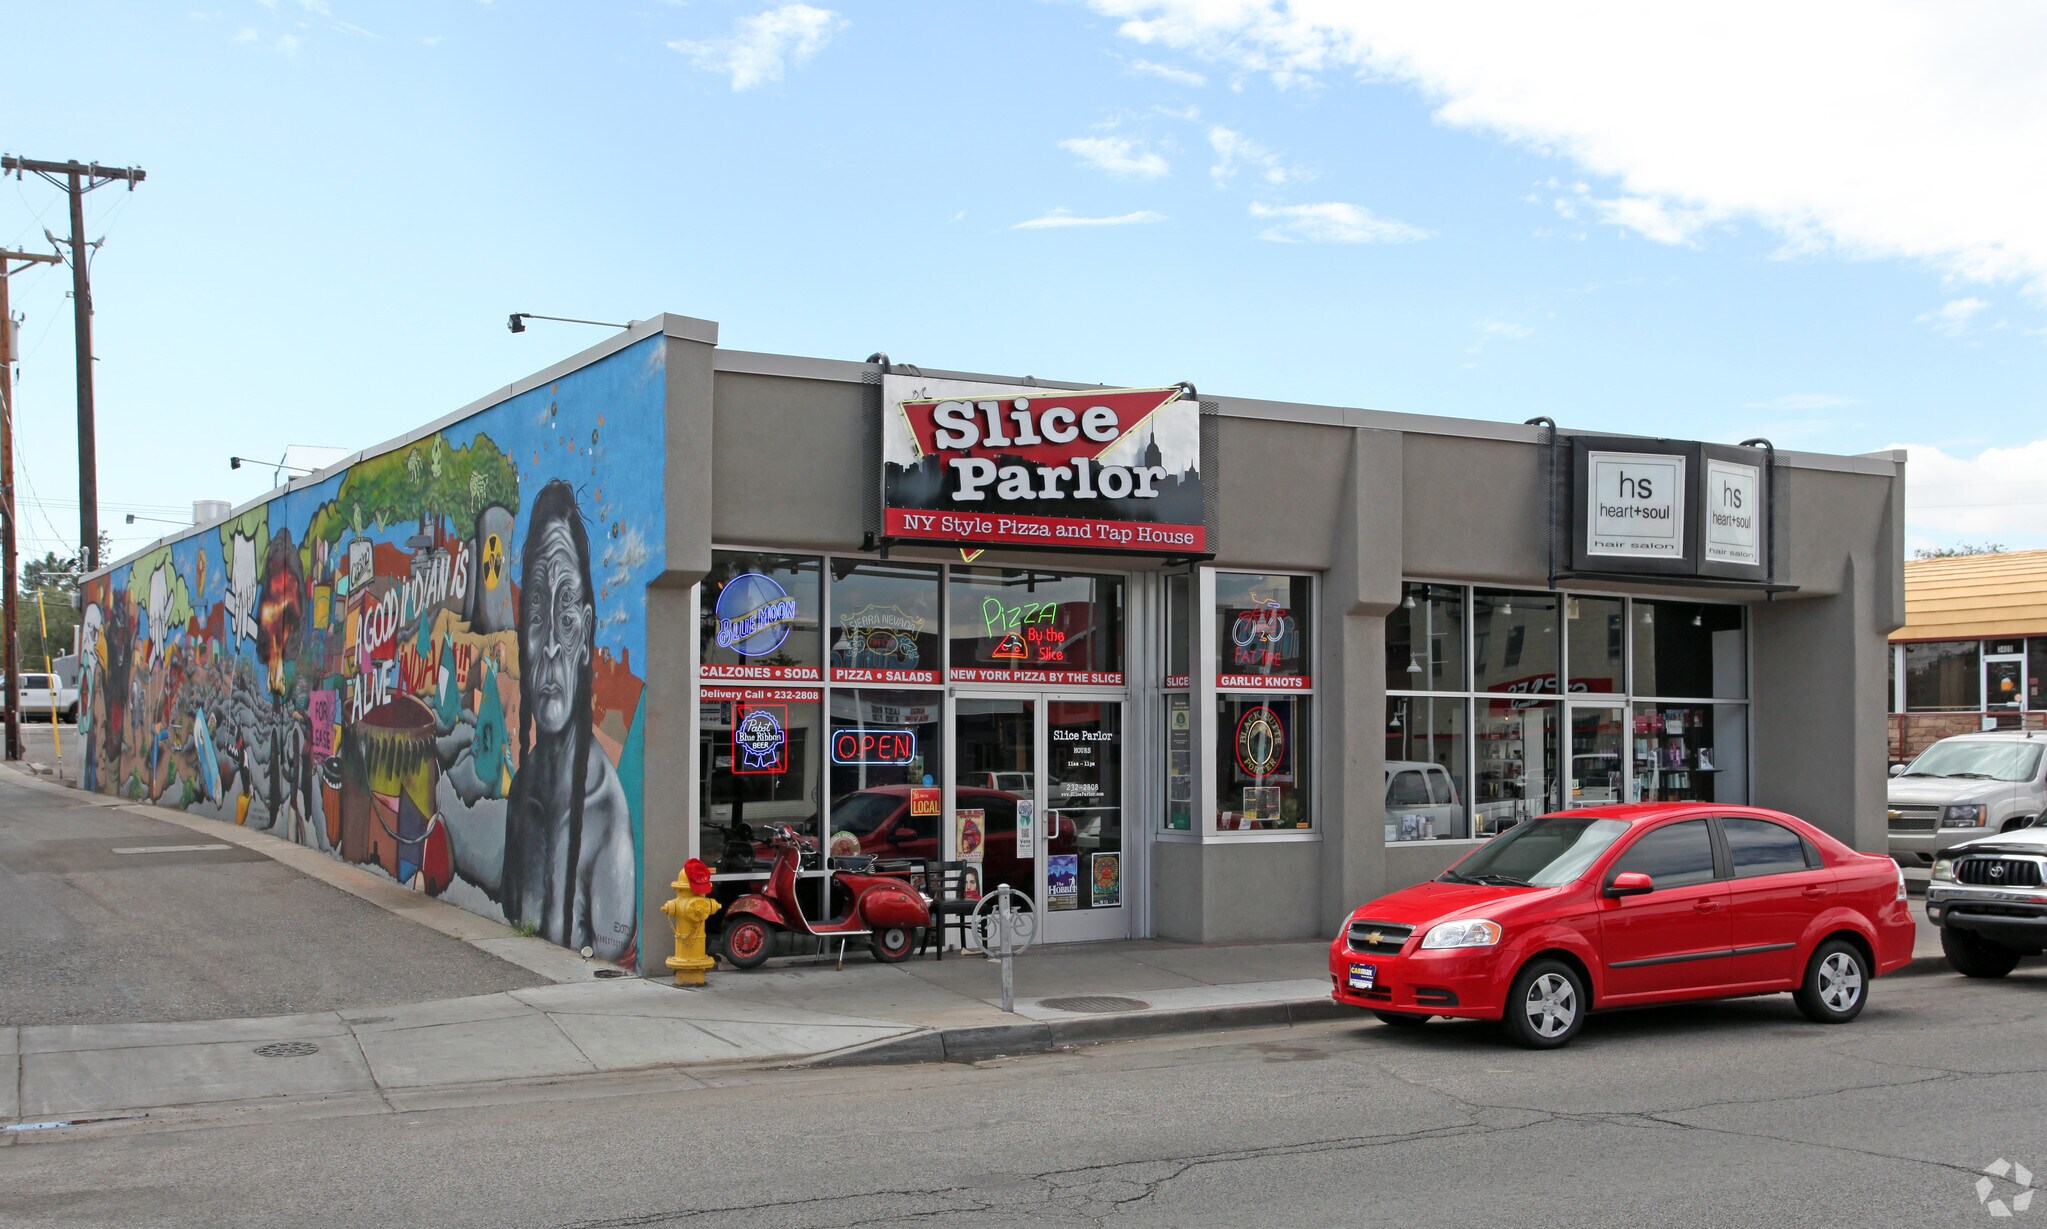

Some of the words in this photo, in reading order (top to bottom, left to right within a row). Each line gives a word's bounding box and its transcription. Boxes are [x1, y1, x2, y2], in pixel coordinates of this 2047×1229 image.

[933, 397, 1120, 450] Slice
[949, 456, 1167, 501] Parlor
[1620, 470, 1653, 499] hs
[1723, 480, 1742, 509] hs
[1600, 502, 1670, 520] heart+soul
[1712, 510, 1751, 529] heart+soul
[903, 514, 934, 531] NY
[941, 517, 992, 535] Style
[997, 519, 1051, 537] Pizza
[1055, 523, 1090, 540] and
[1096, 525, 1133, 544] Tap
[1136, 527, 1195, 545] House
[1594, 541, 1625, 549] hair
[1630, 542, 1675, 550] salon
[1708, 548, 1727, 556] hair
[1729, 550, 1754, 559] salon
[354, 614, 363, 666] A
[363, 587, 399, 653] GOOD
[848, 614, 880, 631] SIERRA
[881, 614, 916, 633] NEVADA
[1028, 628, 1043, 646] By
[1046, 626, 1065, 643] the
[1038, 646, 1064, 661] Slice
[1233, 647, 1256, 665] FAT
[700, 666, 771, 678] CALZONES
[784, 668, 819, 679] SODA
[836, 670, 873, 681] PIZZA
[886, 671, 933, 682] SALADS
[950, 669, 976, 680] NEW
[979, 670, 1011, 681] YORK
[1014, 671, 1046, 682] PIZZA
[1049, 672, 1064, 682] BY
[1066, 673, 1089, 683] THE
[1091, 674, 1122, 684] SLICE
[1166, 676, 1190, 687] SLICE
[1221, 676, 1262, 687] GARLIC
[1265, 676, 1303, 687] KNOTS
[352, 659, 395, 723] ALIVE
[700, 689, 742, 700] Delivery
[744, 690, 764, 699] Call
[774, 690, 819, 700] 232-2808
[315, 700, 328, 721] FOR
[747, 719, 772, 732] Pabst
[1239, 711, 1262, 744] BLACK
[1263, 711, 1283, 745] BUTTE
[739, 733, 755, 741] Blue
[756, 731, 782, 742] Ribbon
[1053, 730, 1080, 740] Slice
[1081, 730, 1113, 740] Parlor
[838, 735, 910, 759] OPEN
[1244, 757, 1277, 774] PORTER
[1066, 783, 1099, 791] 232-2808
[913, 800, 940, 814] LOCAL
